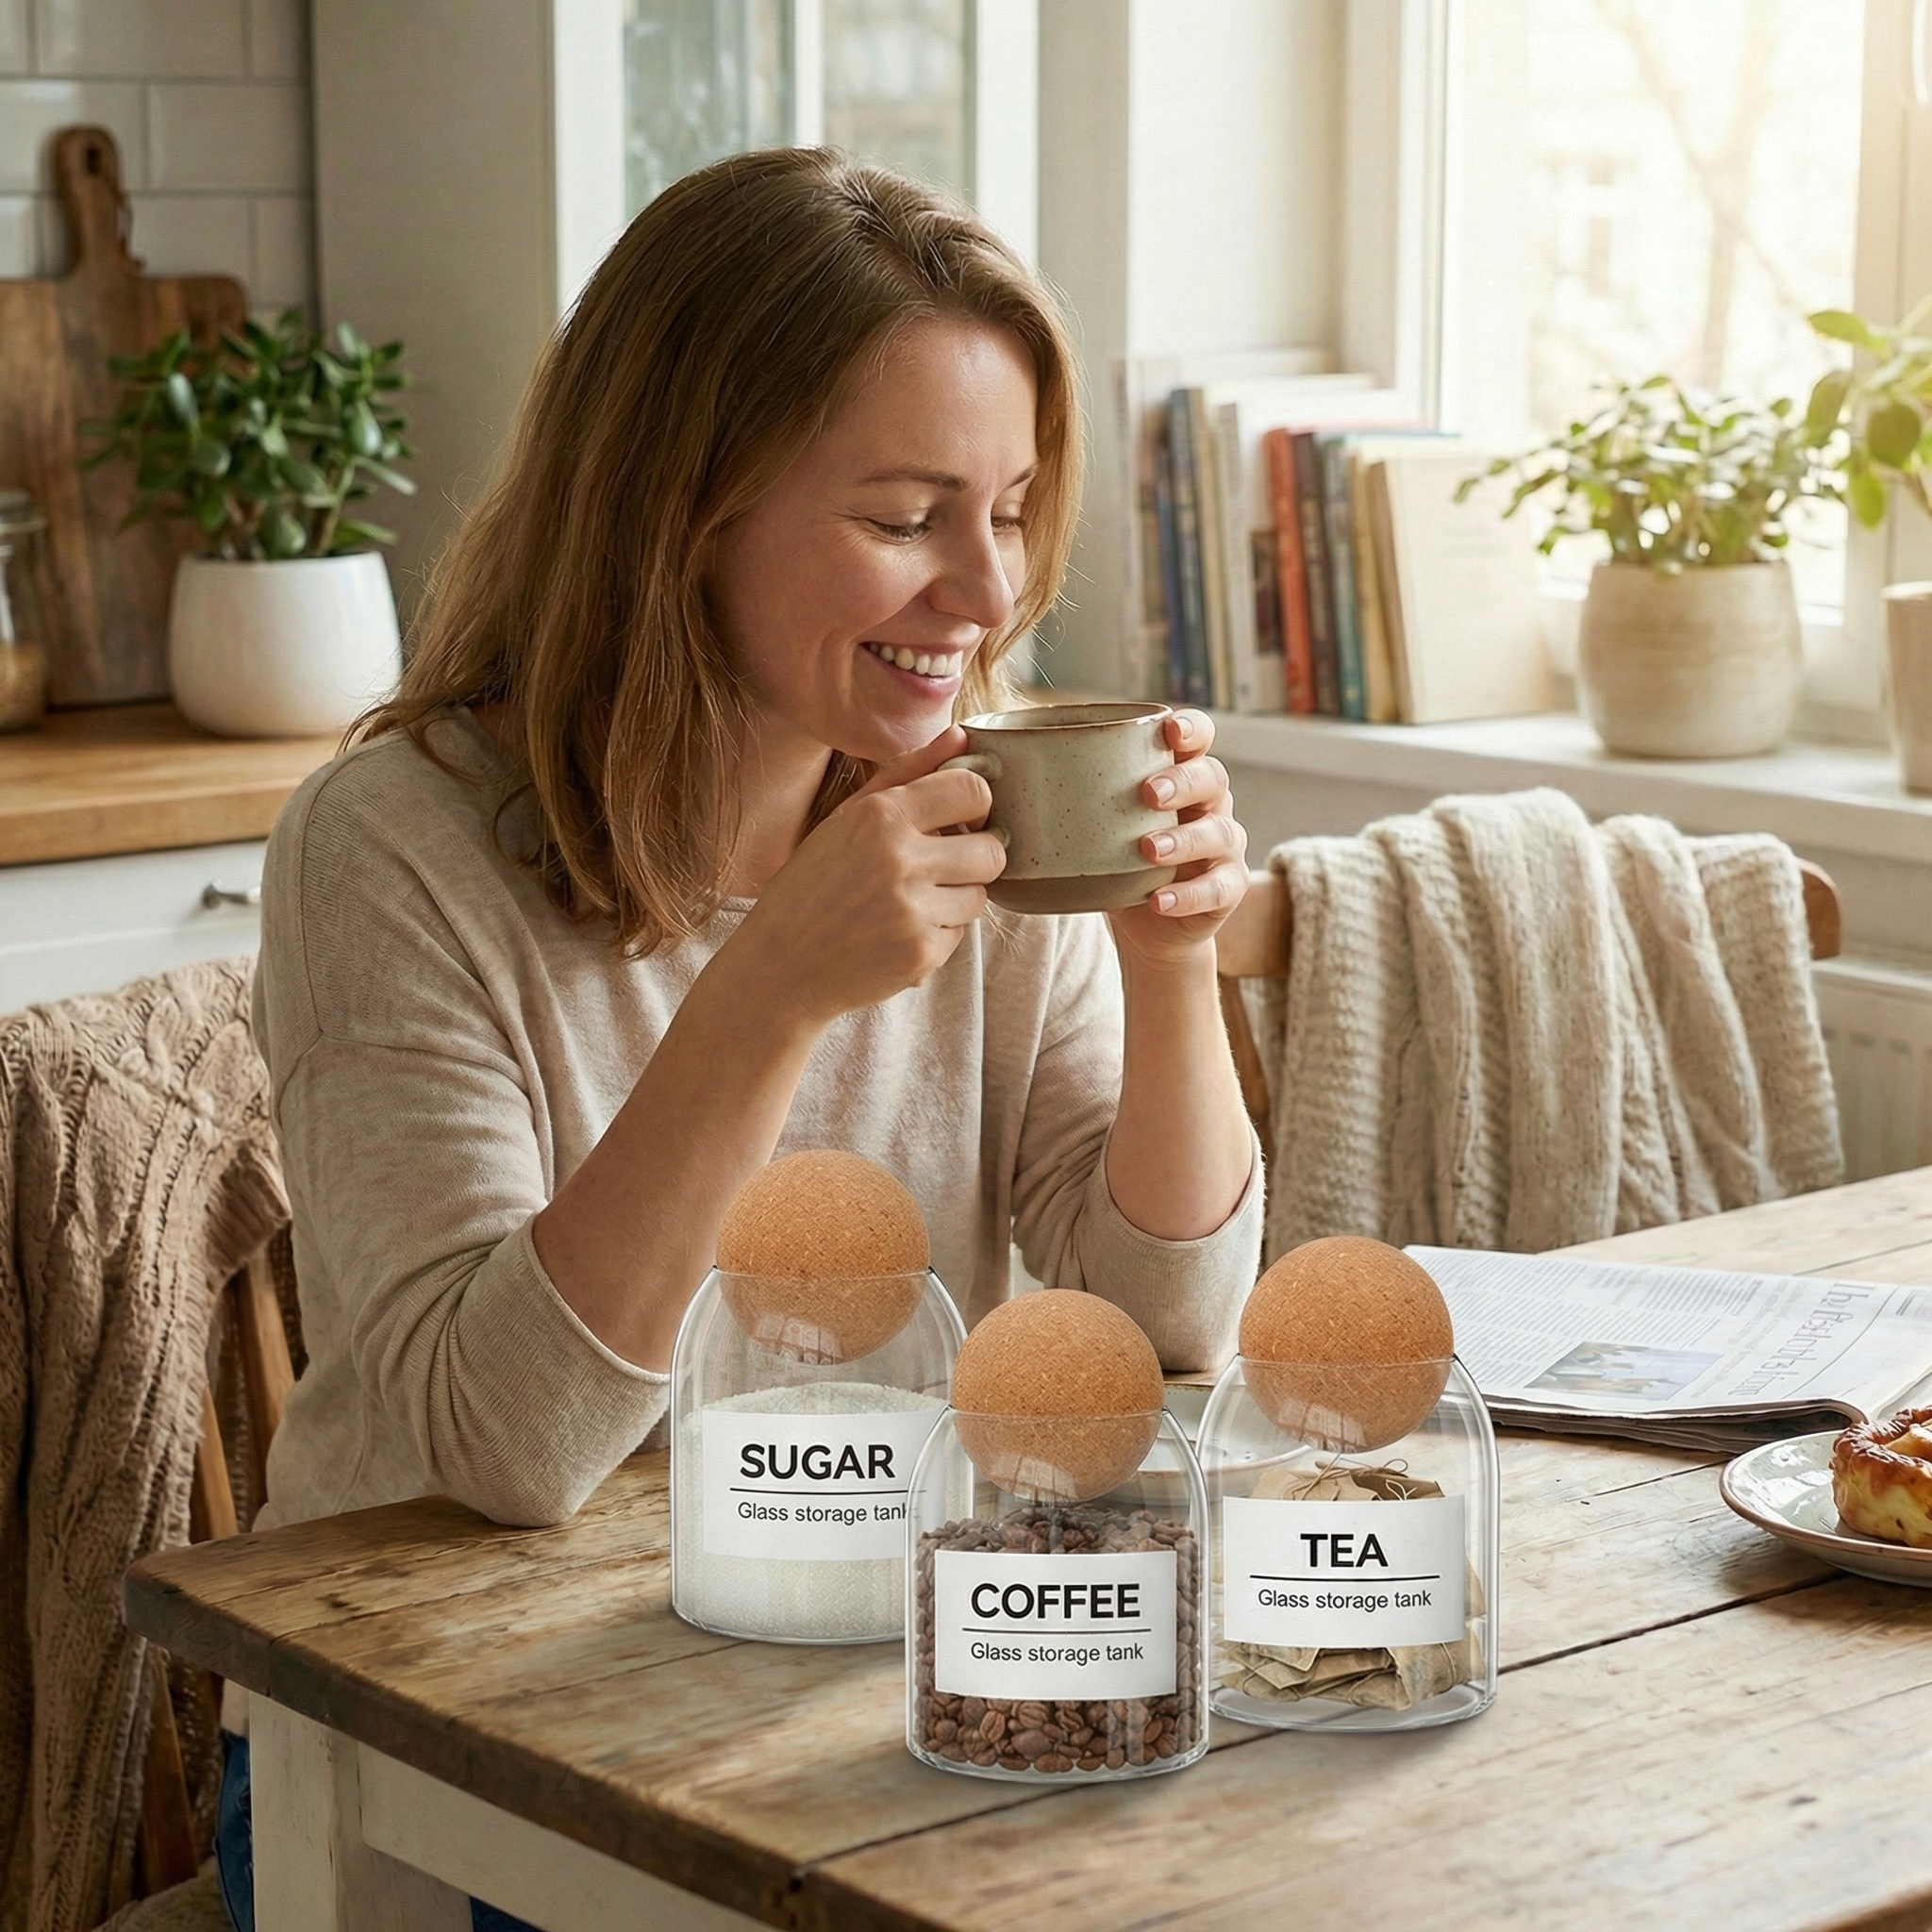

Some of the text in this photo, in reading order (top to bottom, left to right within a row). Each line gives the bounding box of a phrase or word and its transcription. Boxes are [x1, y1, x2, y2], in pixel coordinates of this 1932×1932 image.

[740, 1443, 896, 1480] SUGAR
[738, 1501, 789, 1521] Glass
[794, 1505, 868, 1526] storage
[1300, 1533, 1389, 1568] TEA
[971, 1582, 1141, 1620] COFFEE
[1257, 1589, 1432, 1613] Glass storage tank
[971, 1641, 1144, 1667] Glass storage tank
